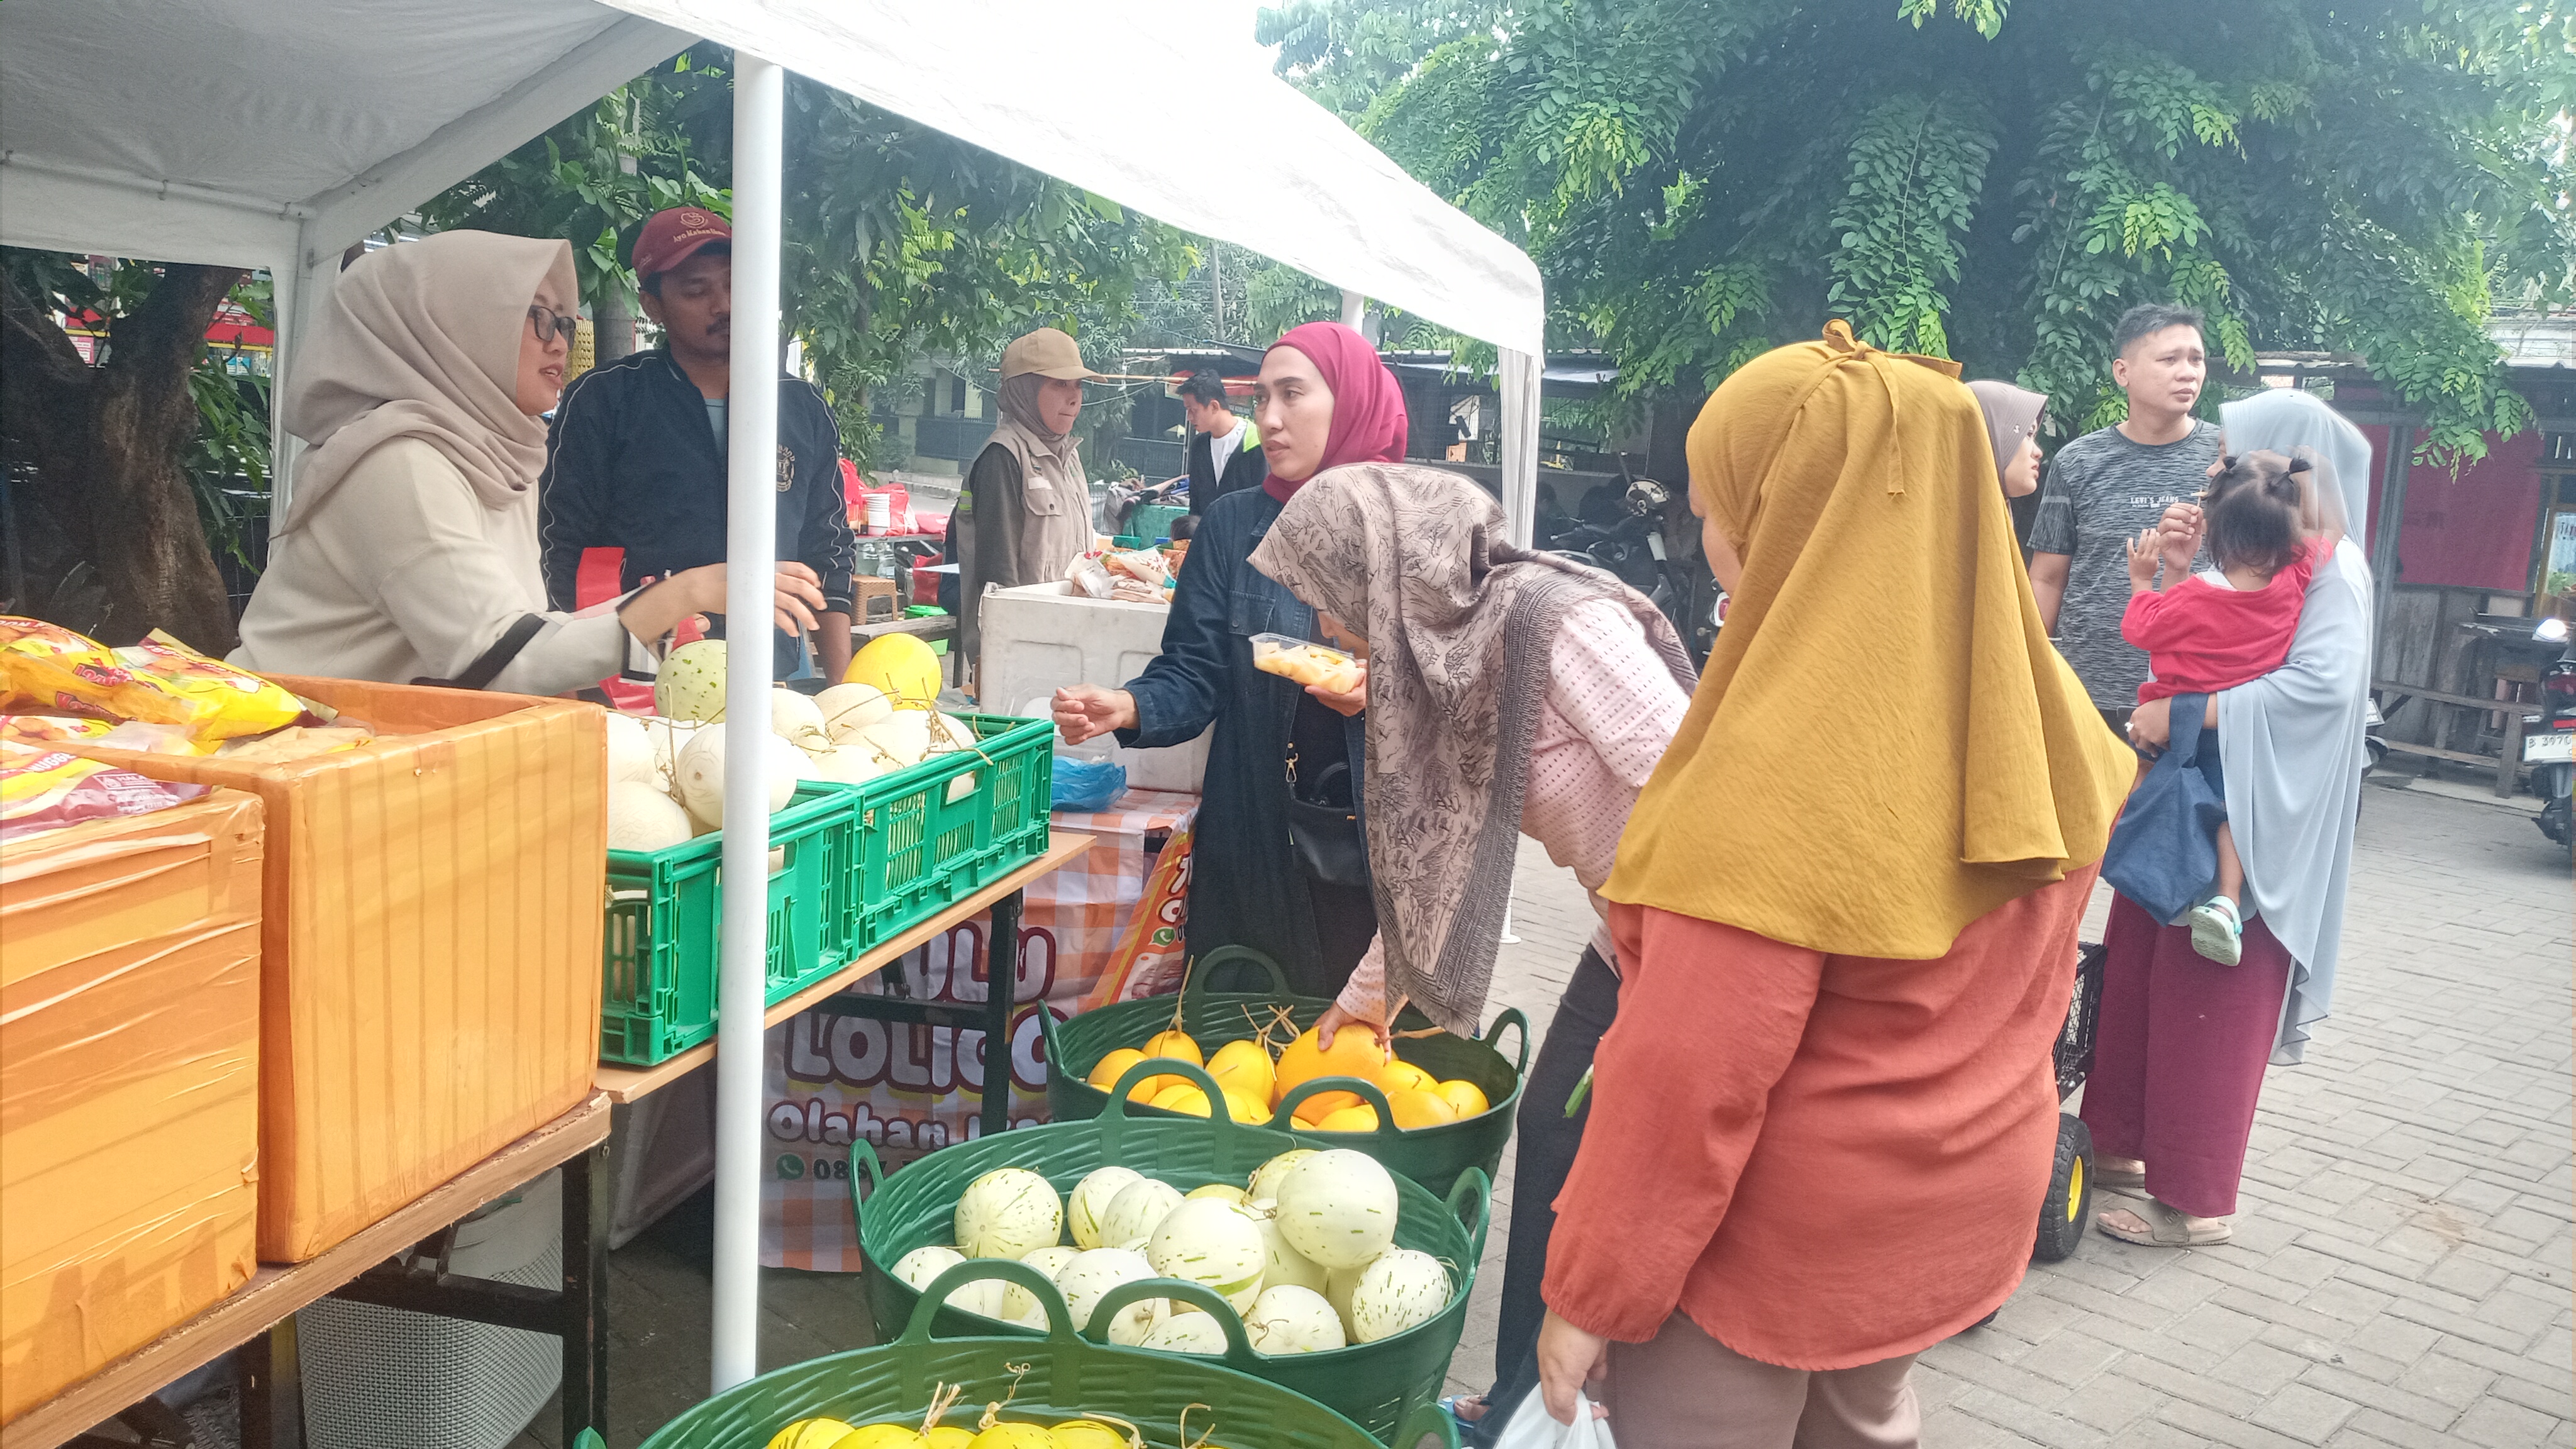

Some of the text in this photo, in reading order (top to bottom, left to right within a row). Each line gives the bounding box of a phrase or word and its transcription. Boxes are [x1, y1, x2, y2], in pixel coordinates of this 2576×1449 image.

[673, 233, 687, 243] Ayo
[2157, 495, 2179, 503] JEANS
[2529, 738, 2536, 748] B
[27, 752, 77, 772] NUGGE
[767, 1097, 950, 1150] Olahan
